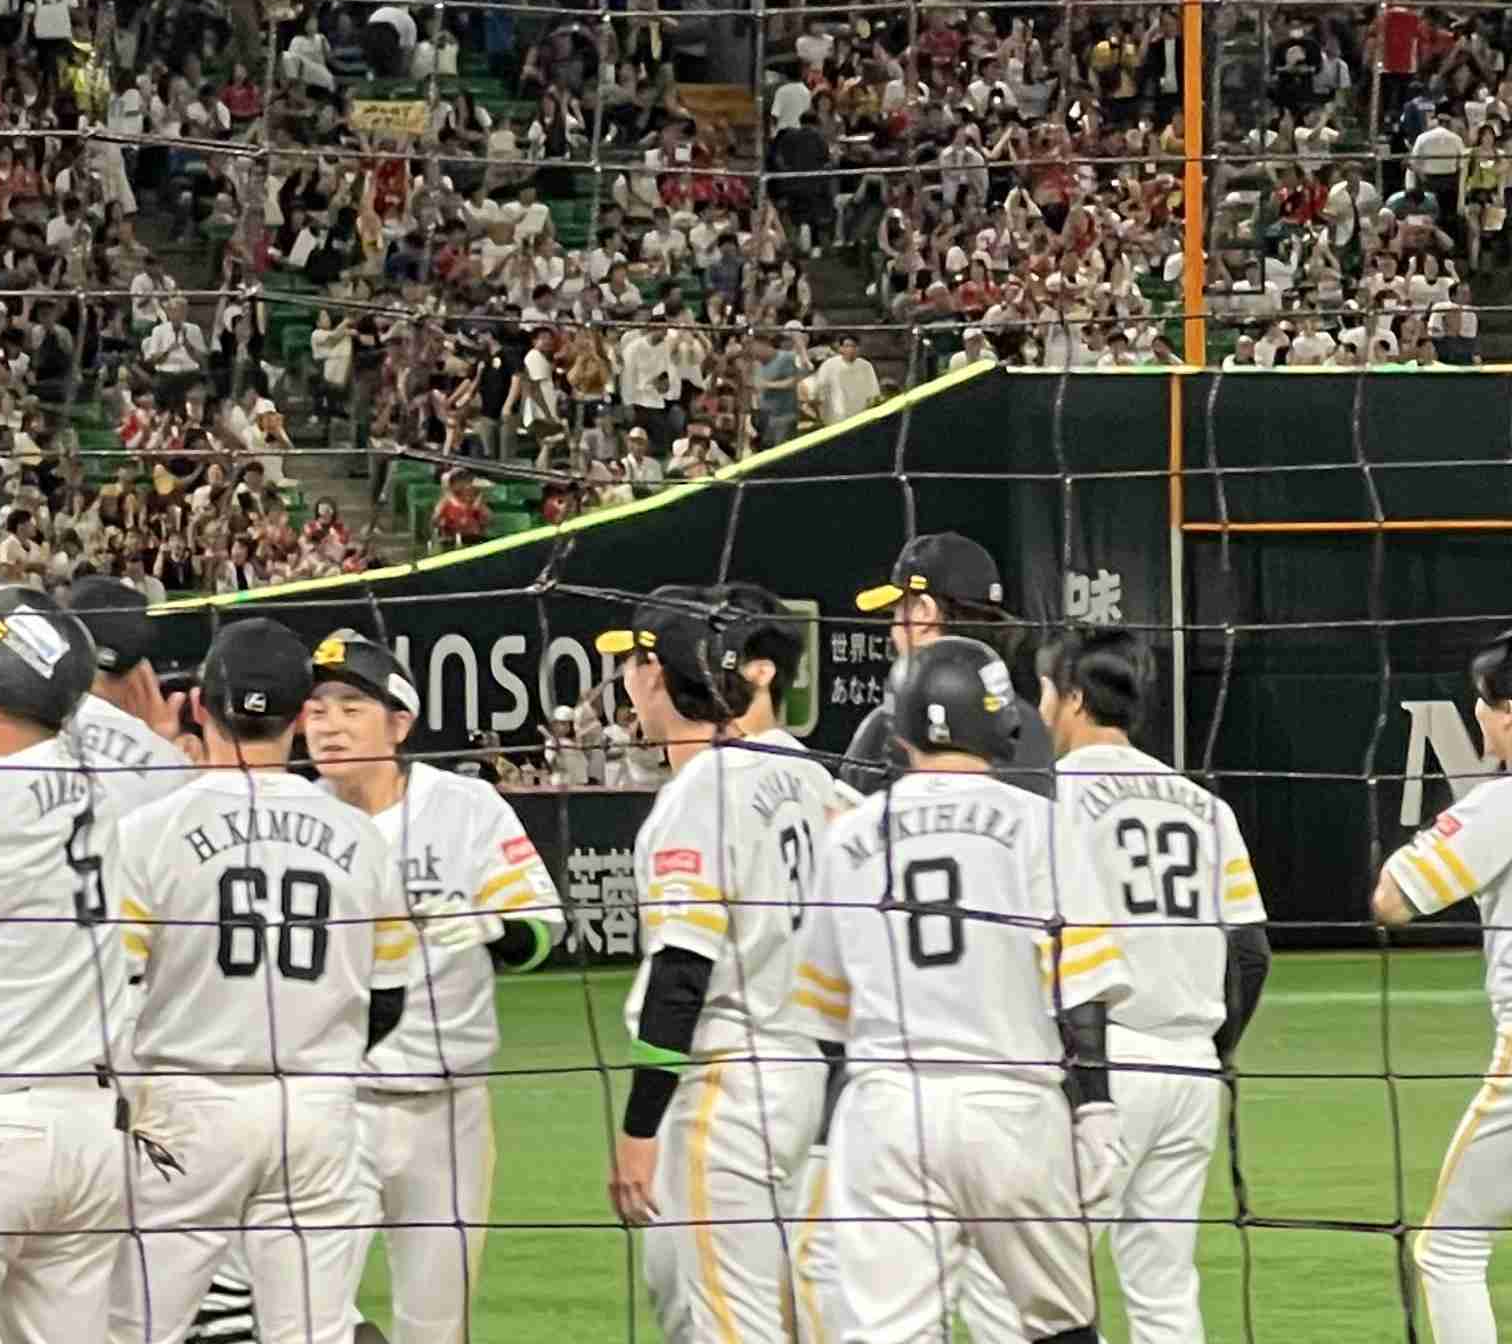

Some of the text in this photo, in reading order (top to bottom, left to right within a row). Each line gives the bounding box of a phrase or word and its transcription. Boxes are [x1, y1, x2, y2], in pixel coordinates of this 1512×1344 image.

[831, 676, 890, 706] あなた
[904, 856, 965, 969] 8
[1115, 817, 1199, 919] 32
[217, 867, 332, 982] 68
